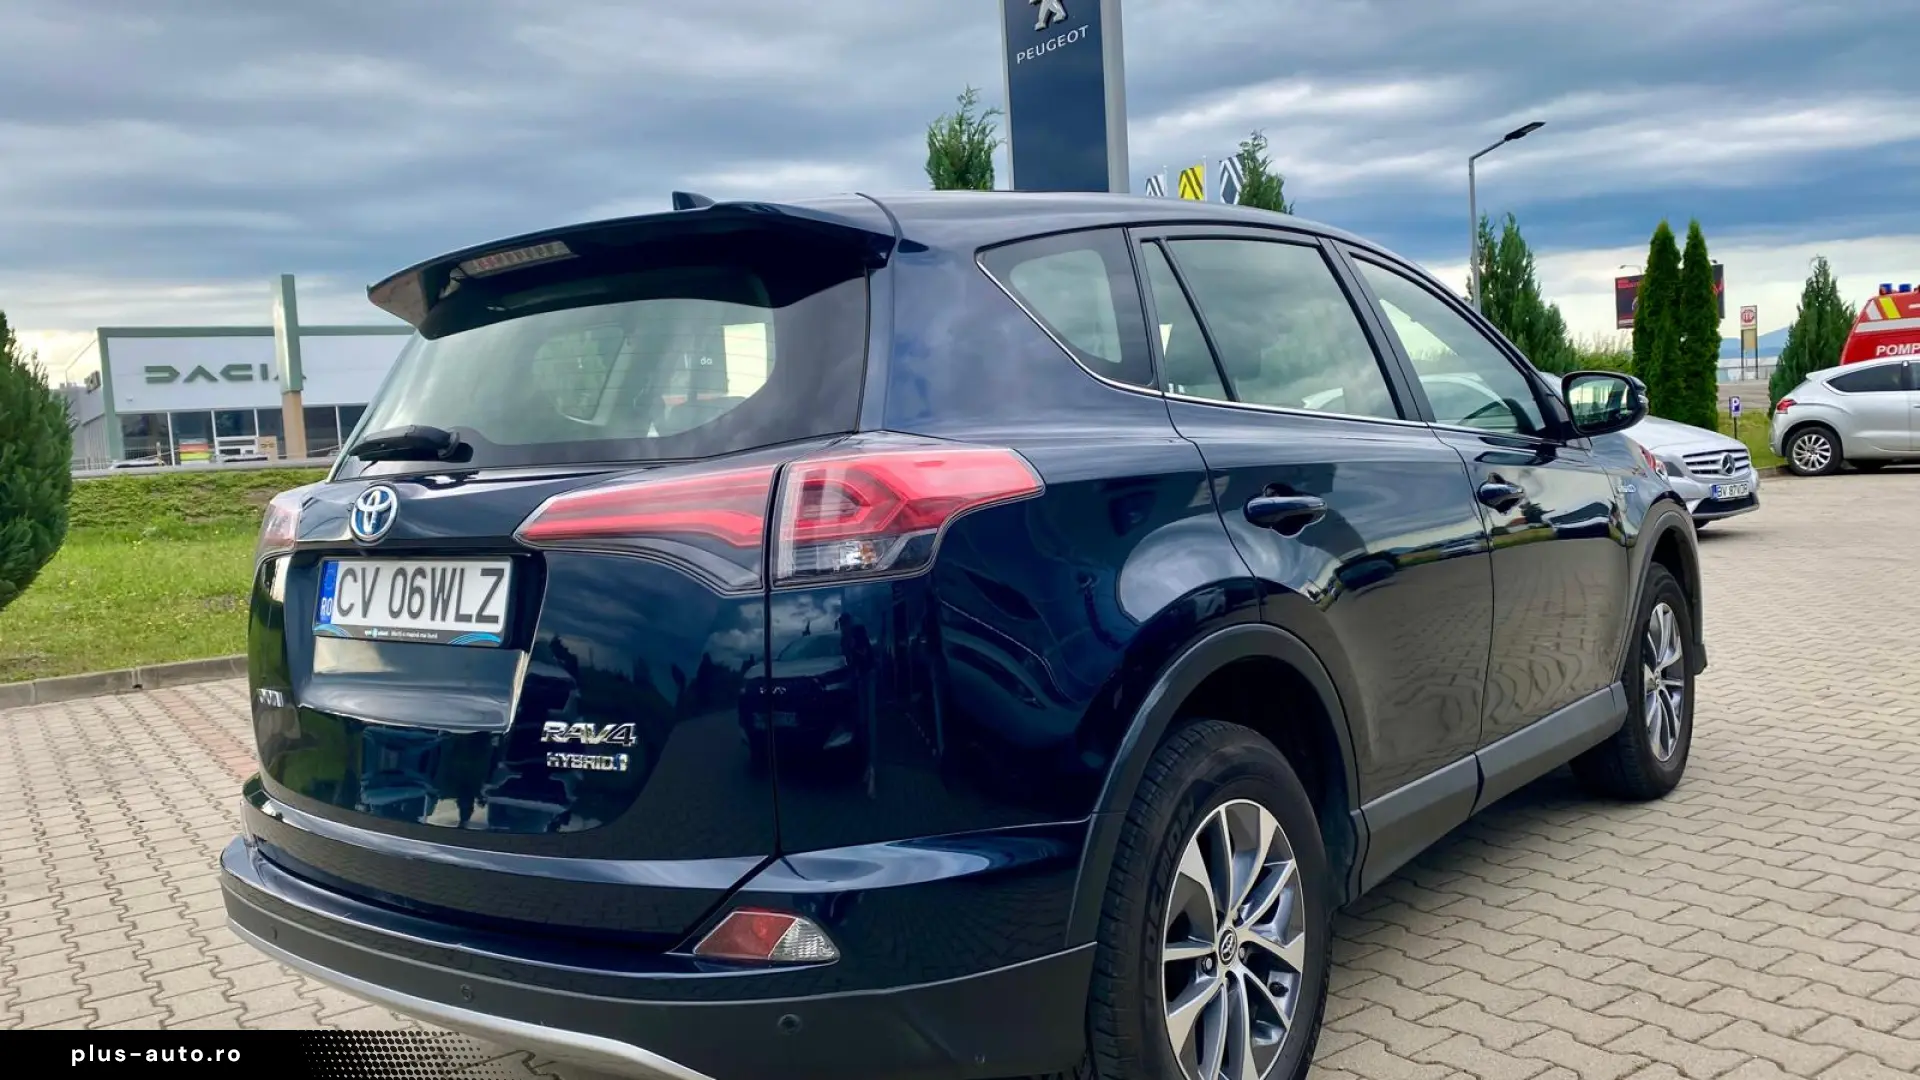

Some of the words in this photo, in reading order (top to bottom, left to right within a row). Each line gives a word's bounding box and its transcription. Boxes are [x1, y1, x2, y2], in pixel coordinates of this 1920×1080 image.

[1016, 24, 1089, 64] PEUGEOT
[144, 363, 307, 384] DACI
[320, 596, 332, 617] RO
[336, 566, 381, 619] CV
[387, 566, 505, 625] 06WLZ
[540, 720, 637, 747] RAV4
[546, 752, 614, 771] HYBRID
